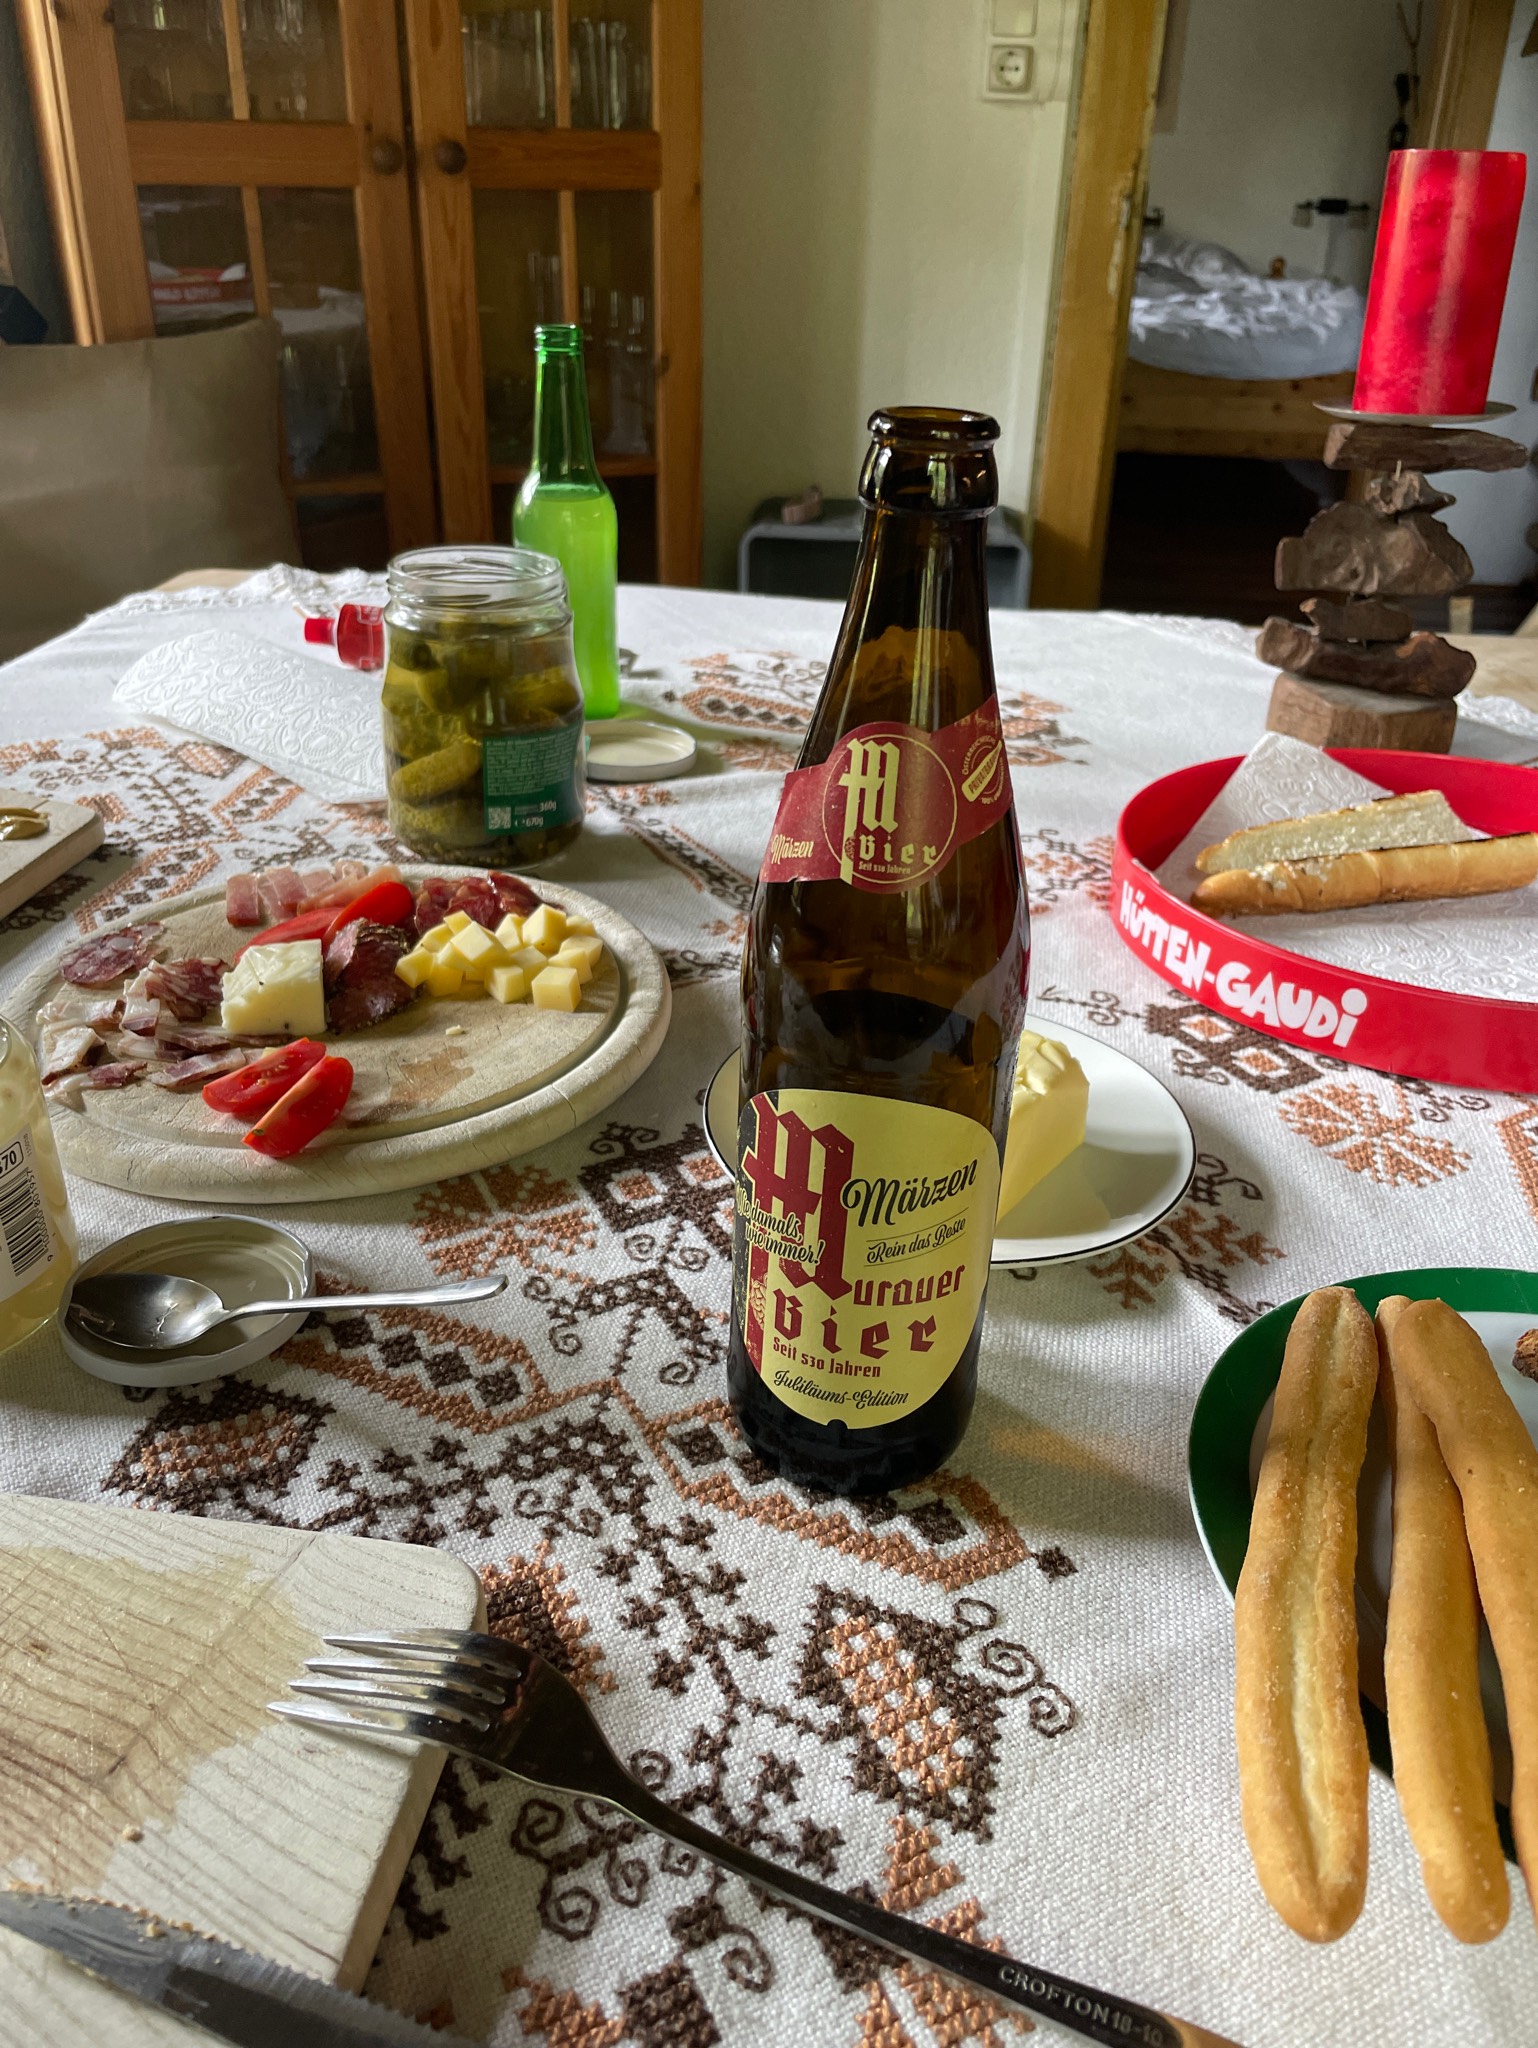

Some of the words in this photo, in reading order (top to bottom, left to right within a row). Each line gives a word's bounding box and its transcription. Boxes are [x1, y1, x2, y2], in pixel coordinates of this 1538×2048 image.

[771, 834, 815, 864] Märzen
[859, 835, 937, 866] Bier
[841, 1159, 978, 1228] Märzen
[746, 1221, 764, 1248] wie
[765, 1232, 825, 1265] immer!
[752, 1199, 803, 1243] damals,
[867, 1236, 906, 1264] Rein
[909, 1236, 931, 1256] das
[933, 1218, 967, 1248] Beste
[773, 1289, 937, 1360] Bier
[773, 1336, 798, 1361] Seit
[801, 1355, 825, 1370] 530
[828, 1360, 881, 1378] Jahren
[1000, 1965, 1109, 2026] CROFTON
